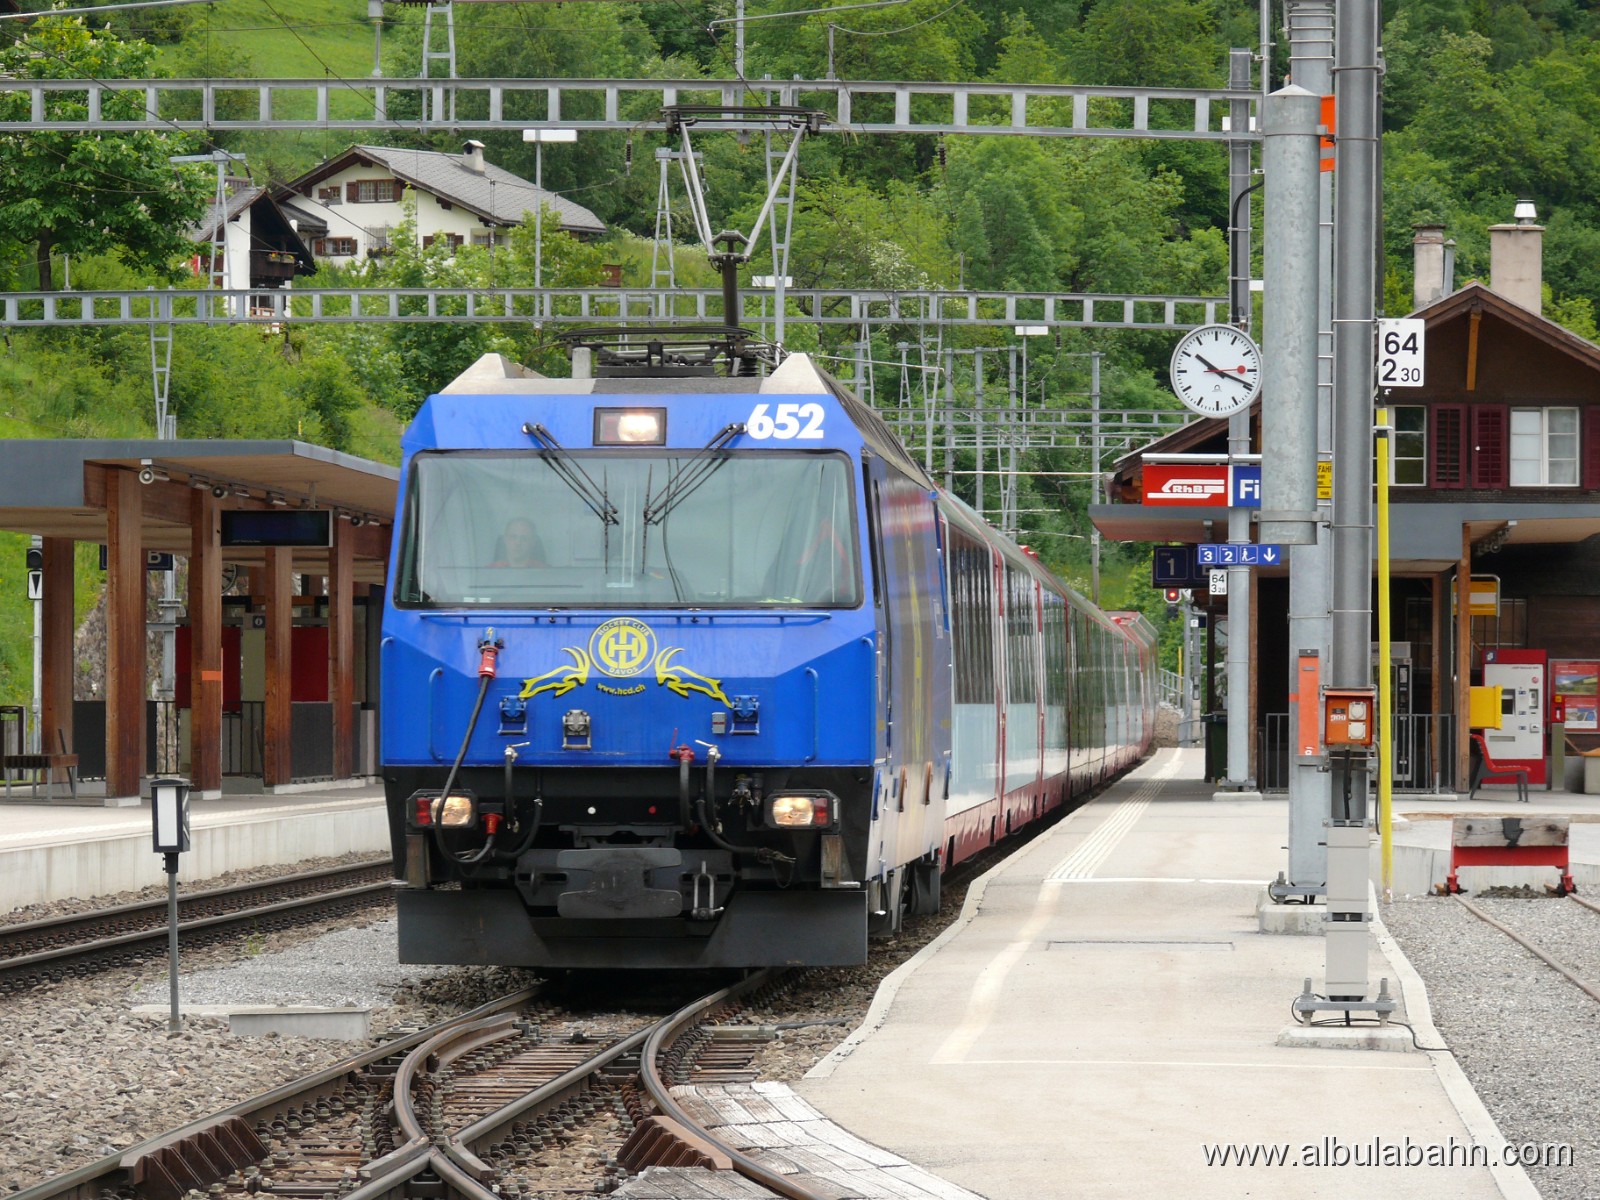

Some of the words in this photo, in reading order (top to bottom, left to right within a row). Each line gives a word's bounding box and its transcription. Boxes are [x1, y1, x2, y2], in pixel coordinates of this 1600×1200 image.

[1385, 331, 1418, 355] 64
[747, 403, 825, 439] 652
[1172, 485, 1204, 493] RhB
[1203, 550, 1213, 562] 3
[1224, 550, 1234, 562] 2
[1167, 558, 1175, 576] 1
[1211, 574, 1225, 583] 64
[597, 620, 630, 636] HOCKEY
[632, 622, 650, 637] CLUB
[609, 667, 638, 675] DAVOS
[597, 682, 646, 696] www.hcd.ch
